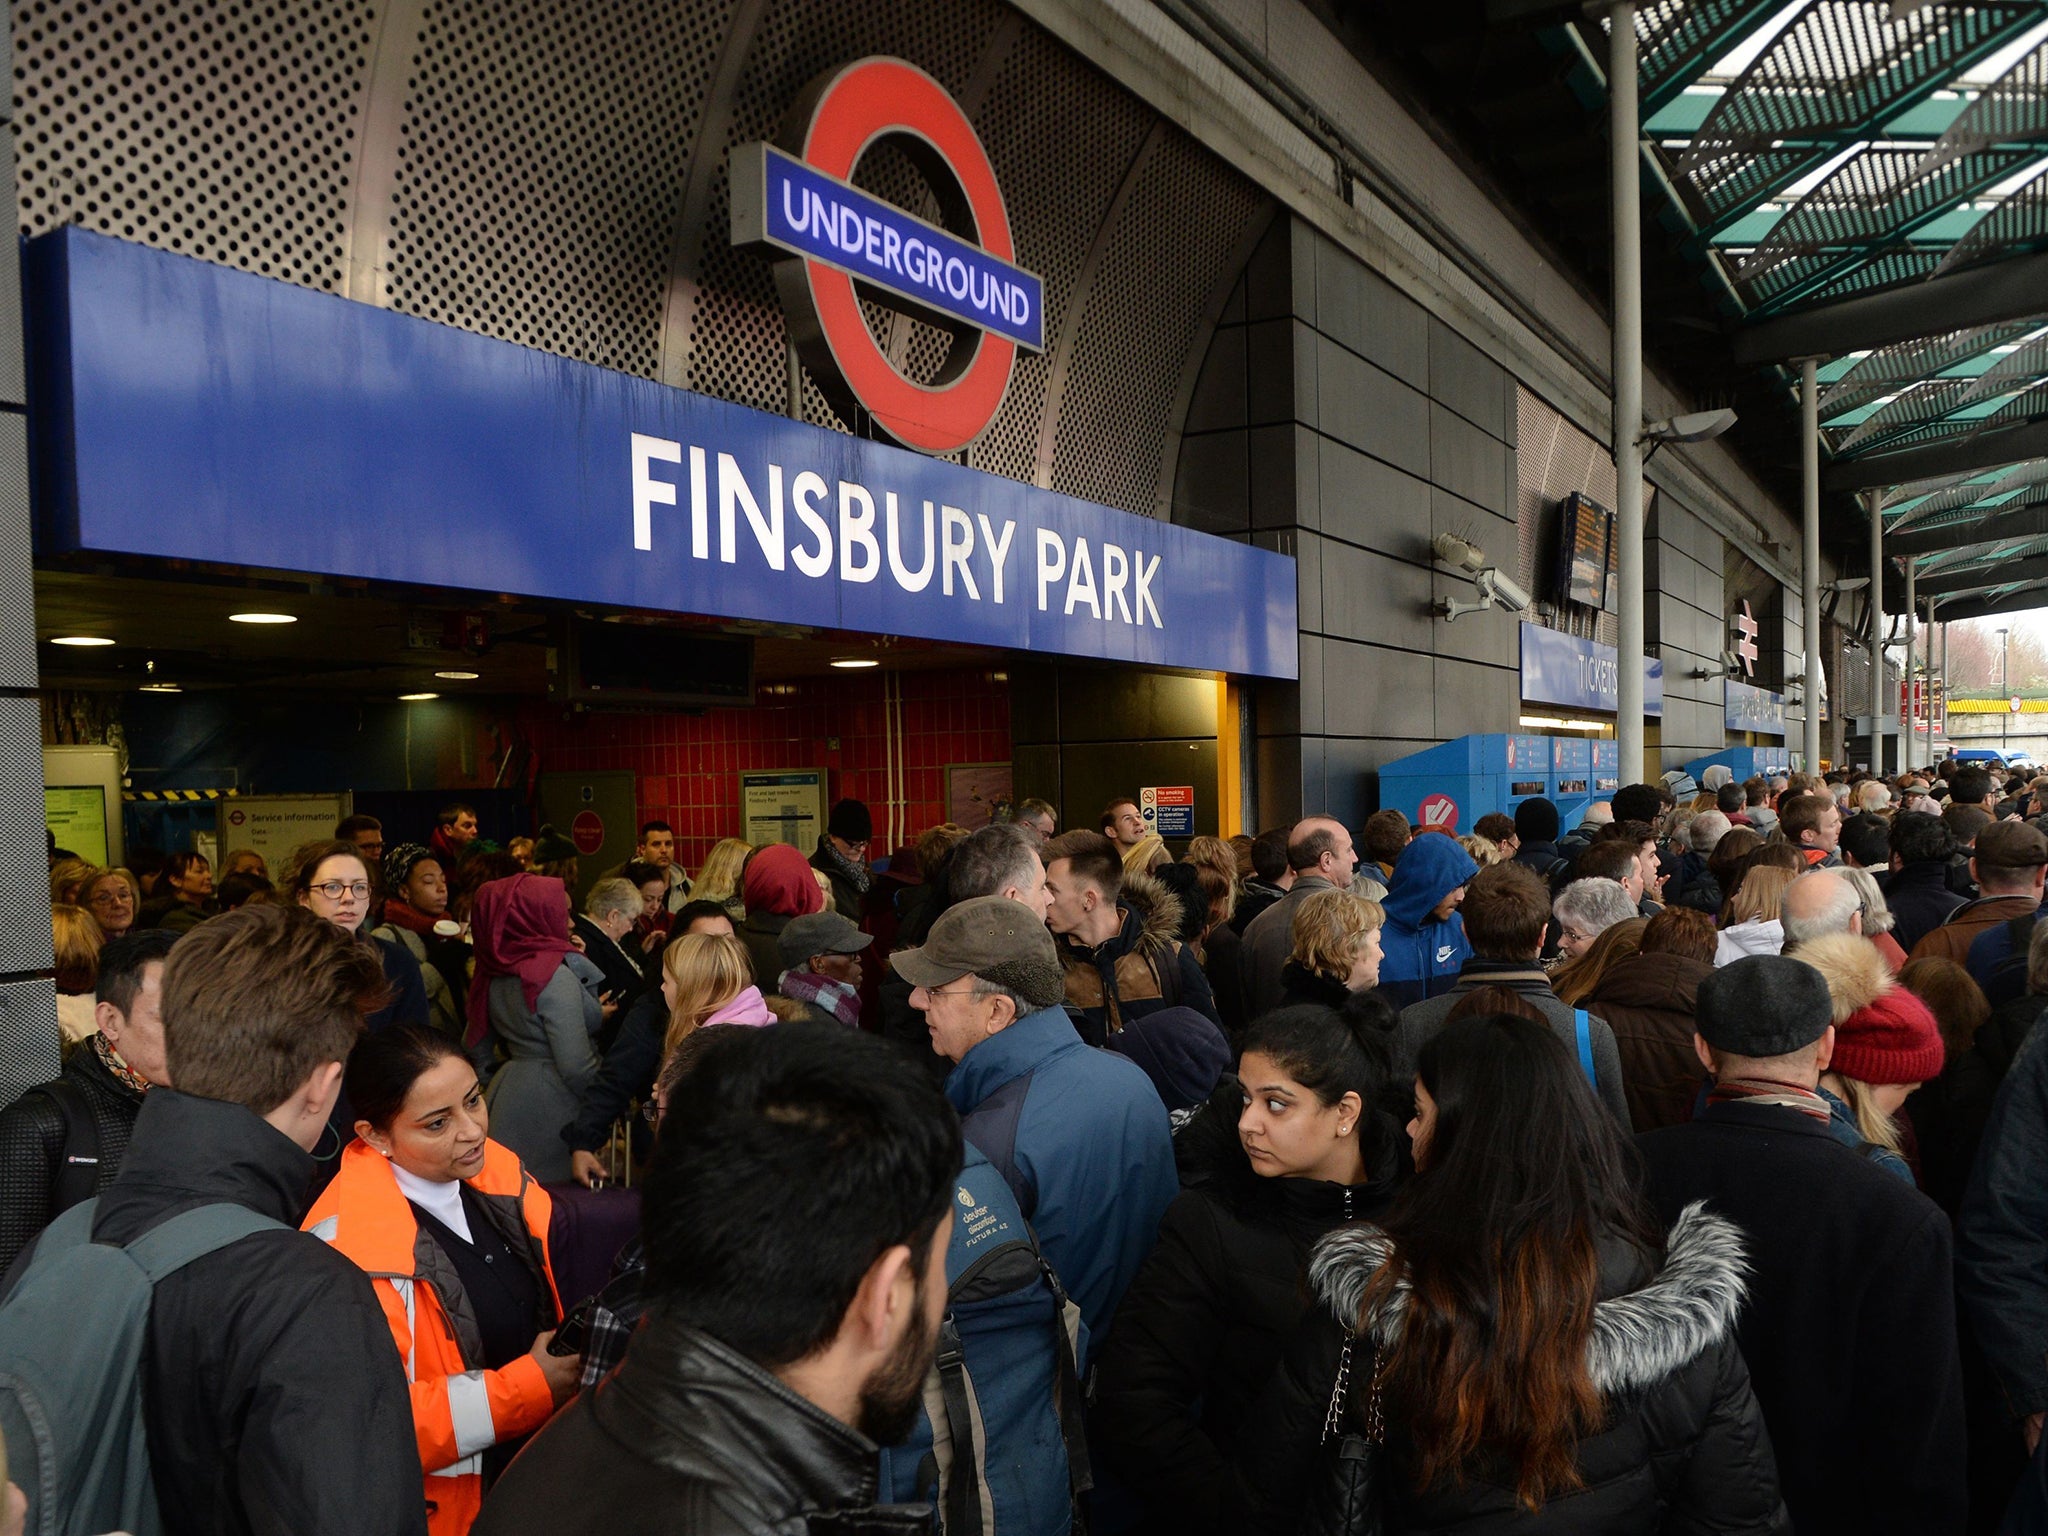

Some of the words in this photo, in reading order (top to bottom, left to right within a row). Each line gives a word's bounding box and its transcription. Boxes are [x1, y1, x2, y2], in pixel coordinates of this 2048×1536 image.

[783, 178, 1029, 326] UNDERGROUND
[631, 431, 1017, 604] FINSBURY
[1037, 527, 1164, 629] PARK
[1578, 654, 1618, 696] TICKETS
[252, 813, 282, 823] Service
[284, 811, 336, 821] information
[1438, 945, 1451, 955] NIKE
[963, 1206, 988, 1223] deuter
[966, 1227, 997, 1248] FUTURA
[999, 1222, 1009, 1230] 42
